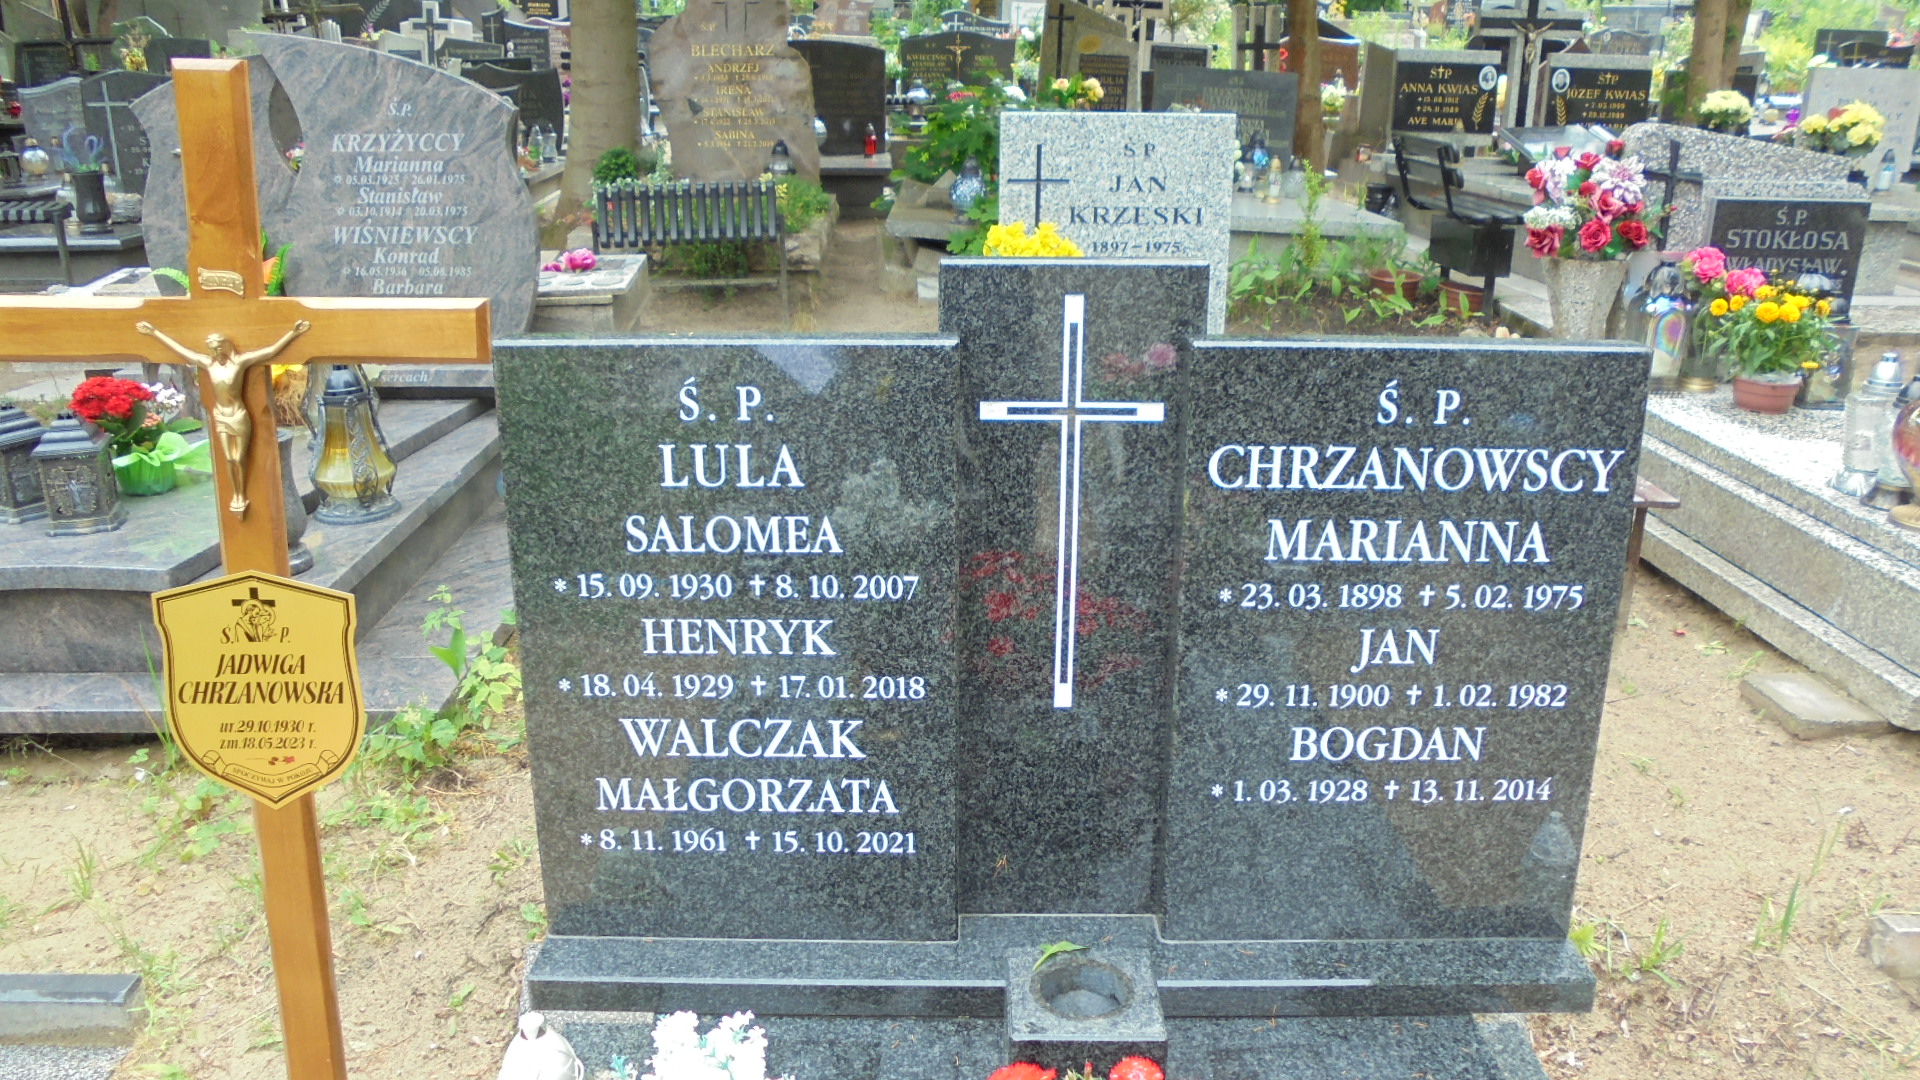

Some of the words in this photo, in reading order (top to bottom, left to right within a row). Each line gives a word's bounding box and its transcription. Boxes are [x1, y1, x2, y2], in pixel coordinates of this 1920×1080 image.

[690, 43, 776, 57] BLECHARZ
[708, 63, 760, 73] ANDRZEJ
[716, 85, 752, 95] IRENA
[1400, 82, 1433, 94] ANNA
[1438, 83, 1479, 95] KWIAS
[1605, 89, 1646, 101] KWIAS
[1408, 116, 1427, 125] AVE
[331, 127, 466, 153] KRZYŻYCCY
[714, 130, 755, 139] SABINA
[354, 155, 445, 174] Marianna
[1109, 174, 1168, 193] JAN
[356, 186, 443, 204] Stanisław
[1069, 206, 1203, 226] KRZESKI
[333, 217, 479, 246] WIŚNIEWSCY
[1725, 229, 1850, 250] STOKŁOSA
[372, 247, 440, 265] Konrad
[371, 278, 444, 295] Barbara
[657, 443, 805, 487] LULA
[1208, 444, 1625, 492] CHRZANOWSCY
[625, 514, 844, 554] SALOMEA
[1263, 519, 1551, 564] MARIANNA
[279, 626, 291, 643] P.
[640, 618, 837, 656] HENRYK
[1349, 628, 1441, 674] JAN
[214, 653, 306, 679] JADWIGA
[177, 680, 345, 705] CHRZANOWSKA
[618, 717, 867, 759] WALCZAK
[1288, 726, 1487, 762] BOGDAN
[594, 777, 900, 814] MAŁGORZATA
